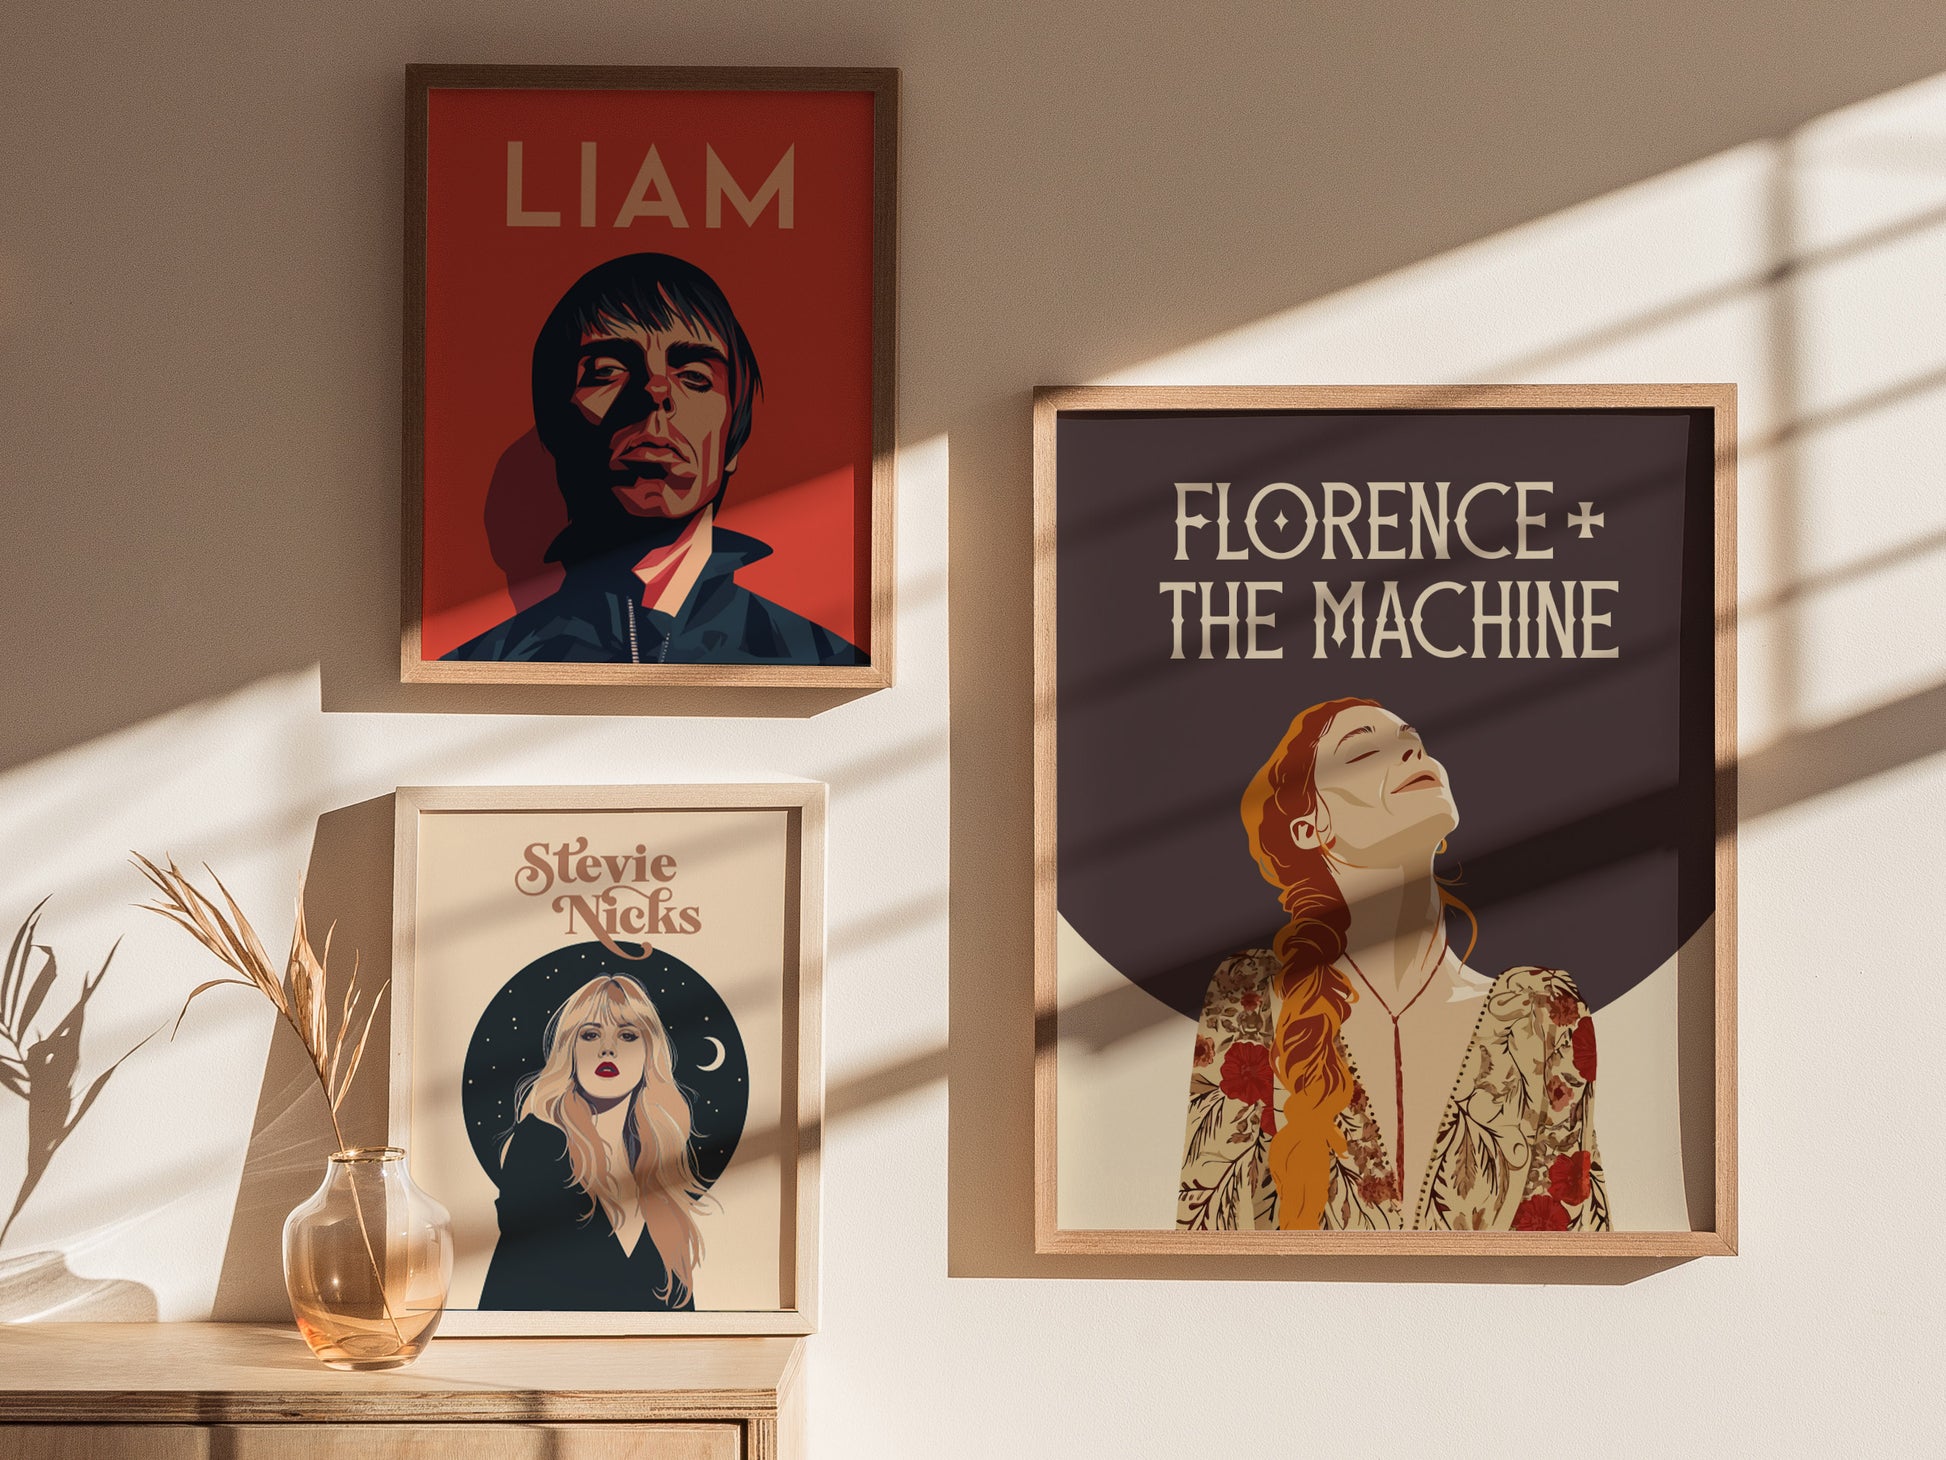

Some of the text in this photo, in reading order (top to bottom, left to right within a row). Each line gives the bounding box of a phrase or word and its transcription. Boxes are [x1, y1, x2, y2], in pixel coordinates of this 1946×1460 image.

[506, 140, 796, 230] LIAM
[1173, 481, 1554, 561] FLORENCE
[1159, 580, 1620, 660] THE MACHINE
[514, 836, 677, 896] Stevie
[551, 885, 702, 961] Nicks
